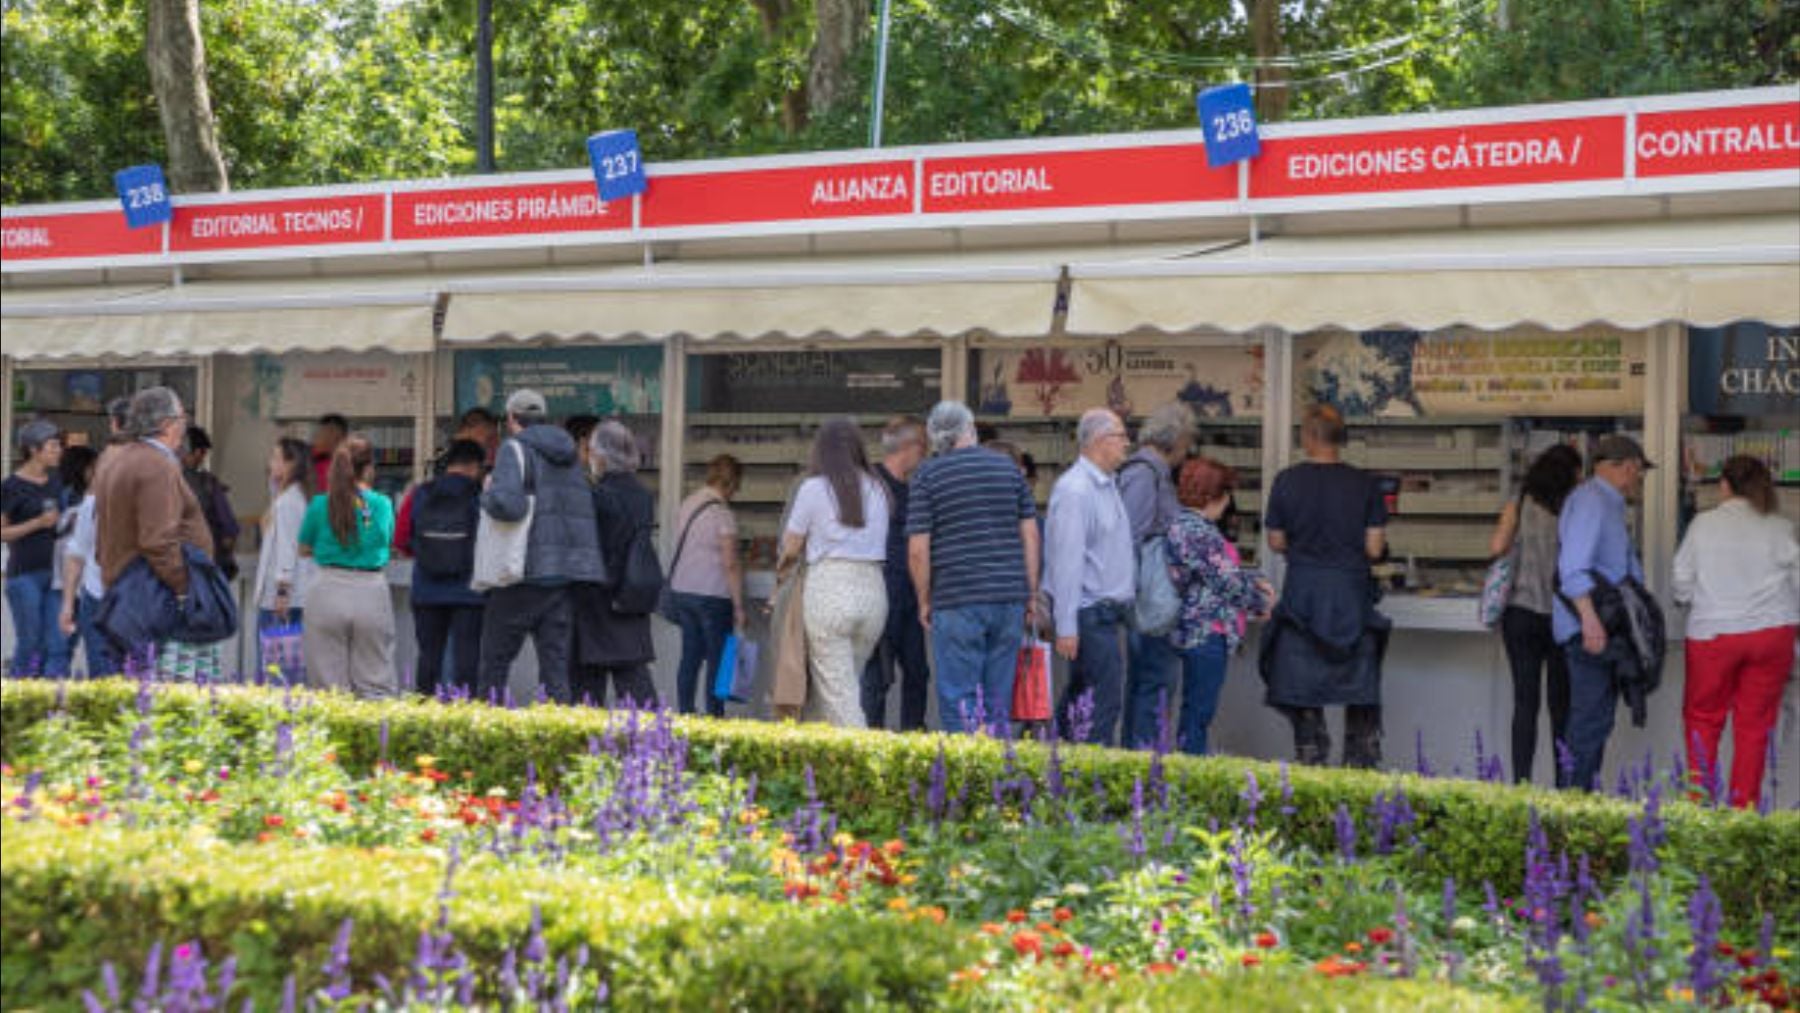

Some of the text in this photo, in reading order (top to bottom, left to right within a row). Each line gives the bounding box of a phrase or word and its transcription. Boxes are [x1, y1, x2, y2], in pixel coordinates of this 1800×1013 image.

[1213, 109, 1253, 142] 236
[602, 150, 638, 179] 237
[1288, 146, 1426, 179] EDICIONES
[1431, 136, 1564, 171] CÁTEDRA
[128, 183, 164, 209] 238
[812, 165, 1053, 206] ALIANZA EDITORIAL
[192, 213, 278, 238] EDITORIAL
[283, 208, 352, 233] TECNOS
[414, 198, 513, 226] EDICIONES
